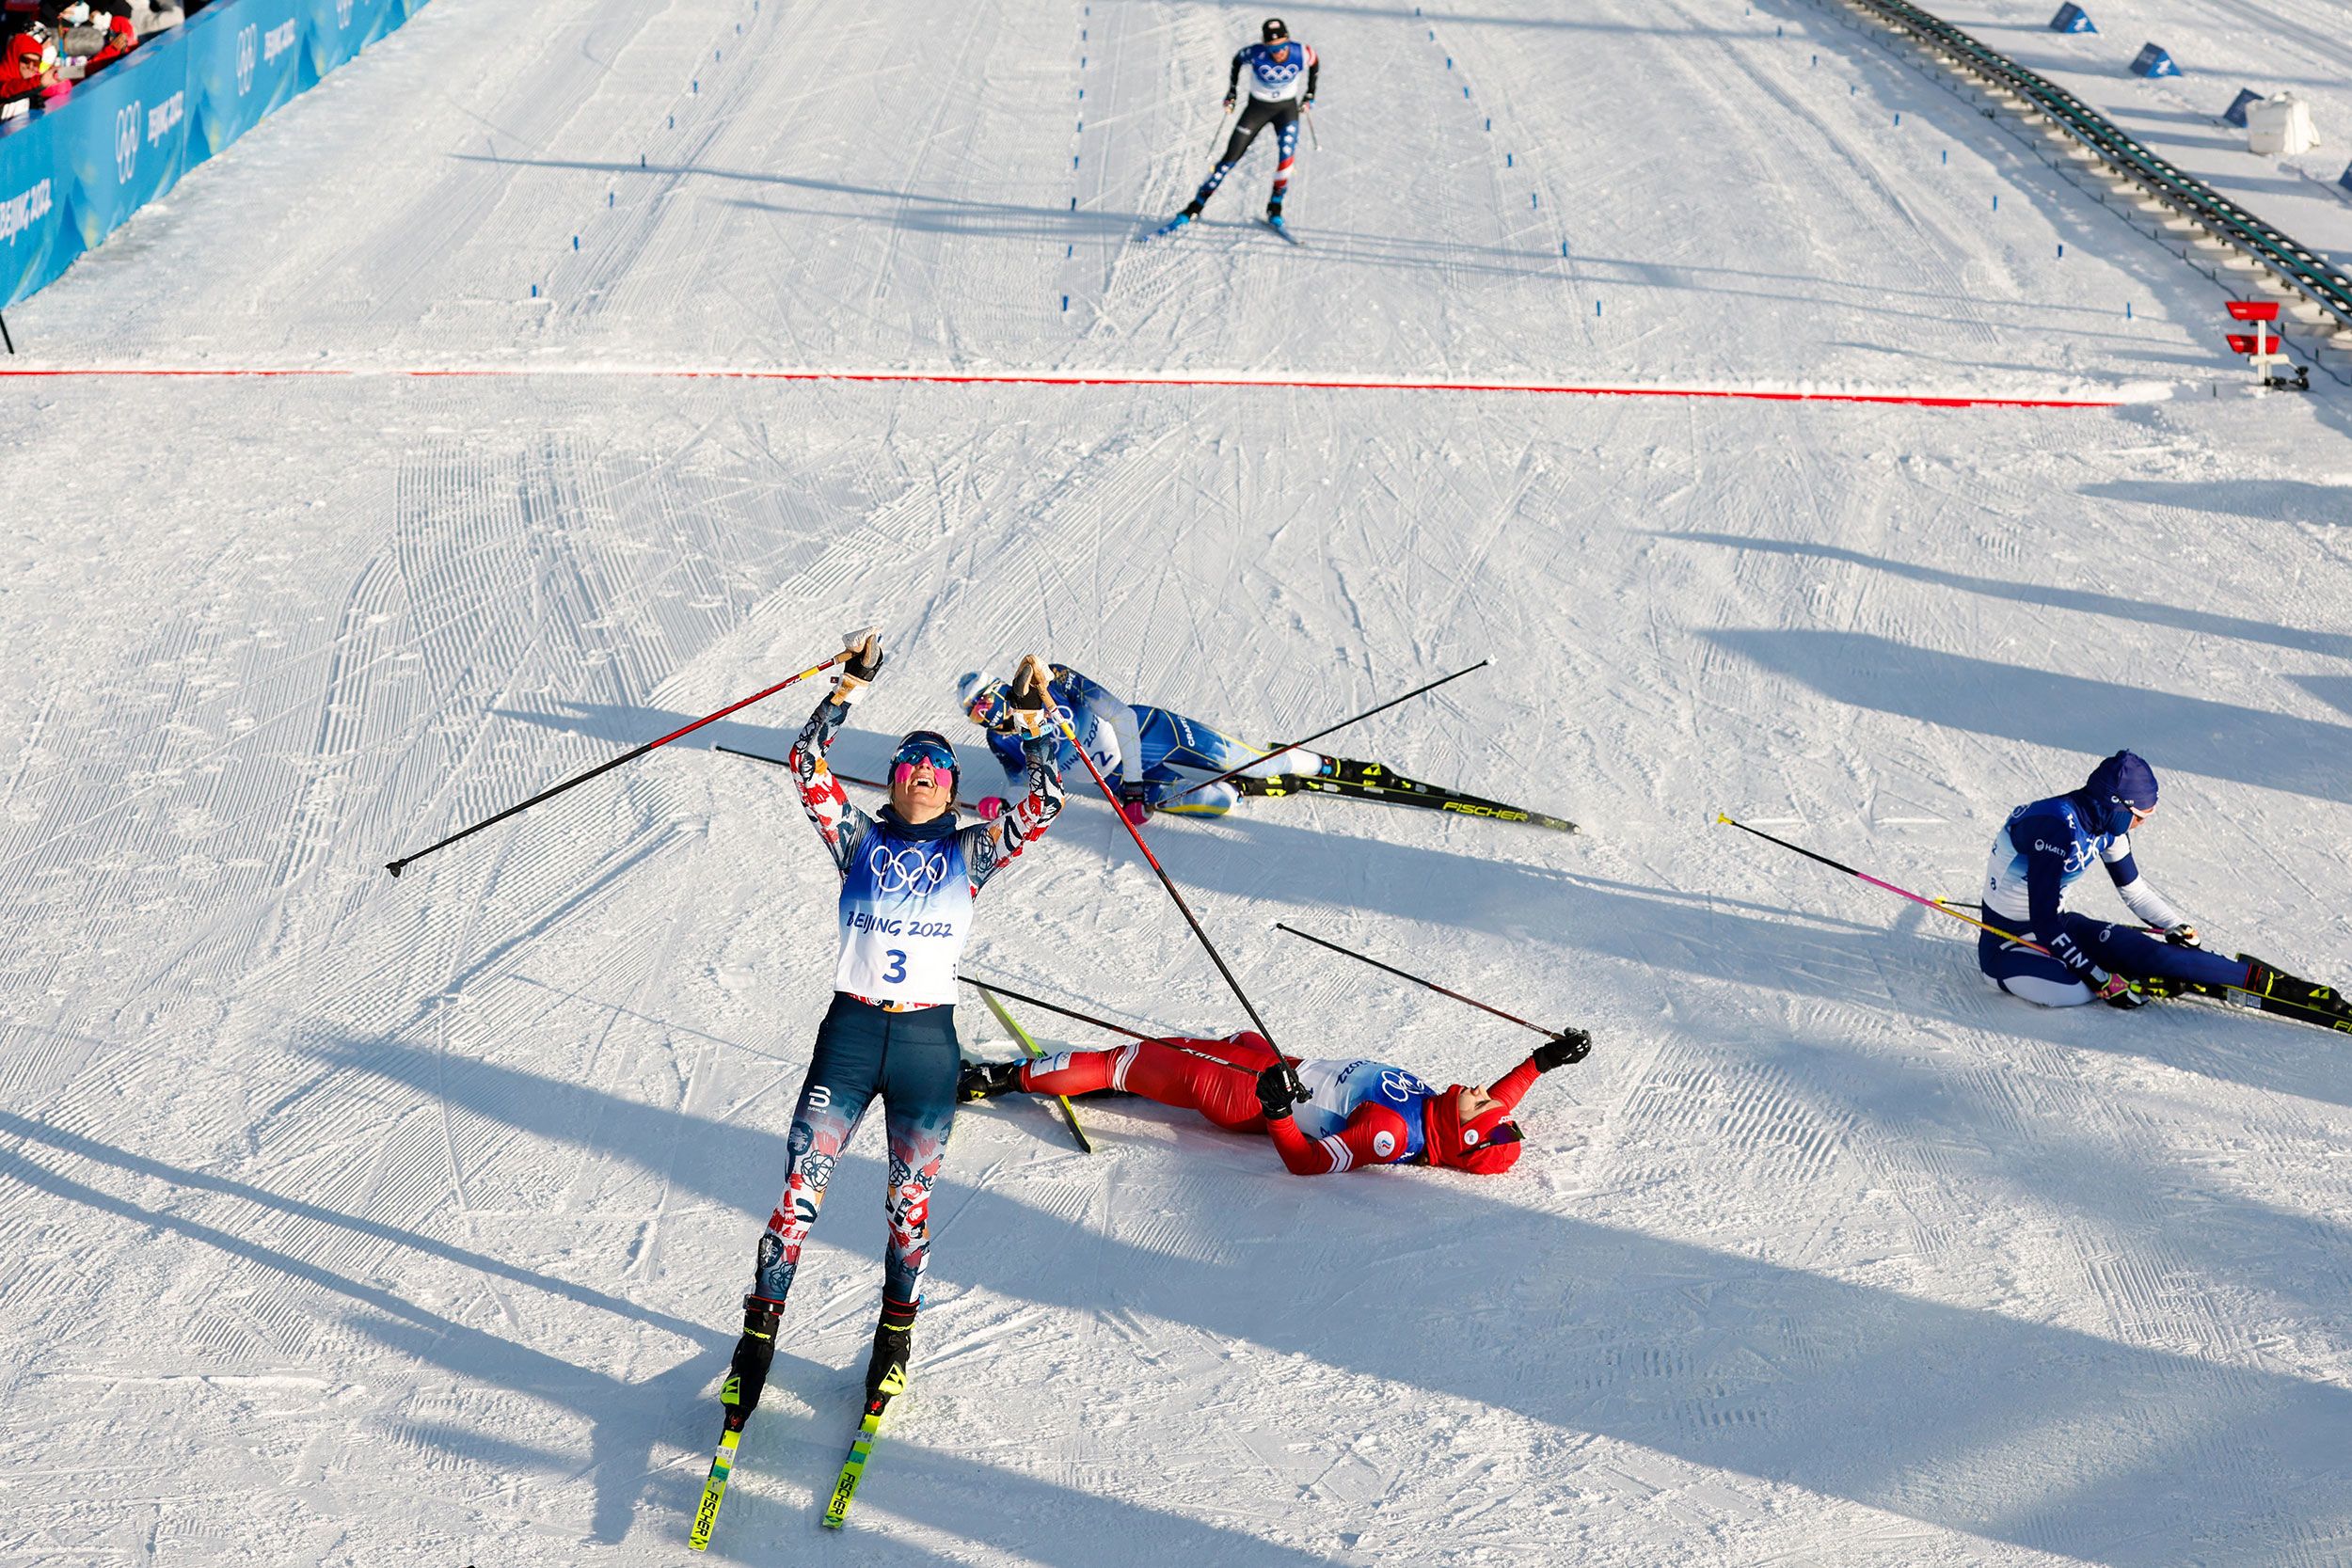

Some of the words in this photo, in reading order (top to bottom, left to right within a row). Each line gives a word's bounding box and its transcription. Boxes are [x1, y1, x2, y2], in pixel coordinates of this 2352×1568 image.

[989, 710, 1003, 726] SWE
[1442, 801, 1529, 821] FISCHER
[847, 911, 903, 936] BEIJING
[907, 921, 953, 938] 2022
[882, 948, 907, 984] 3
[2051, 932, 2090, 969] FIN
[830, 1471, 856, 1515] FISCHER
[694, 1490, 719, 1537] FISCHER
